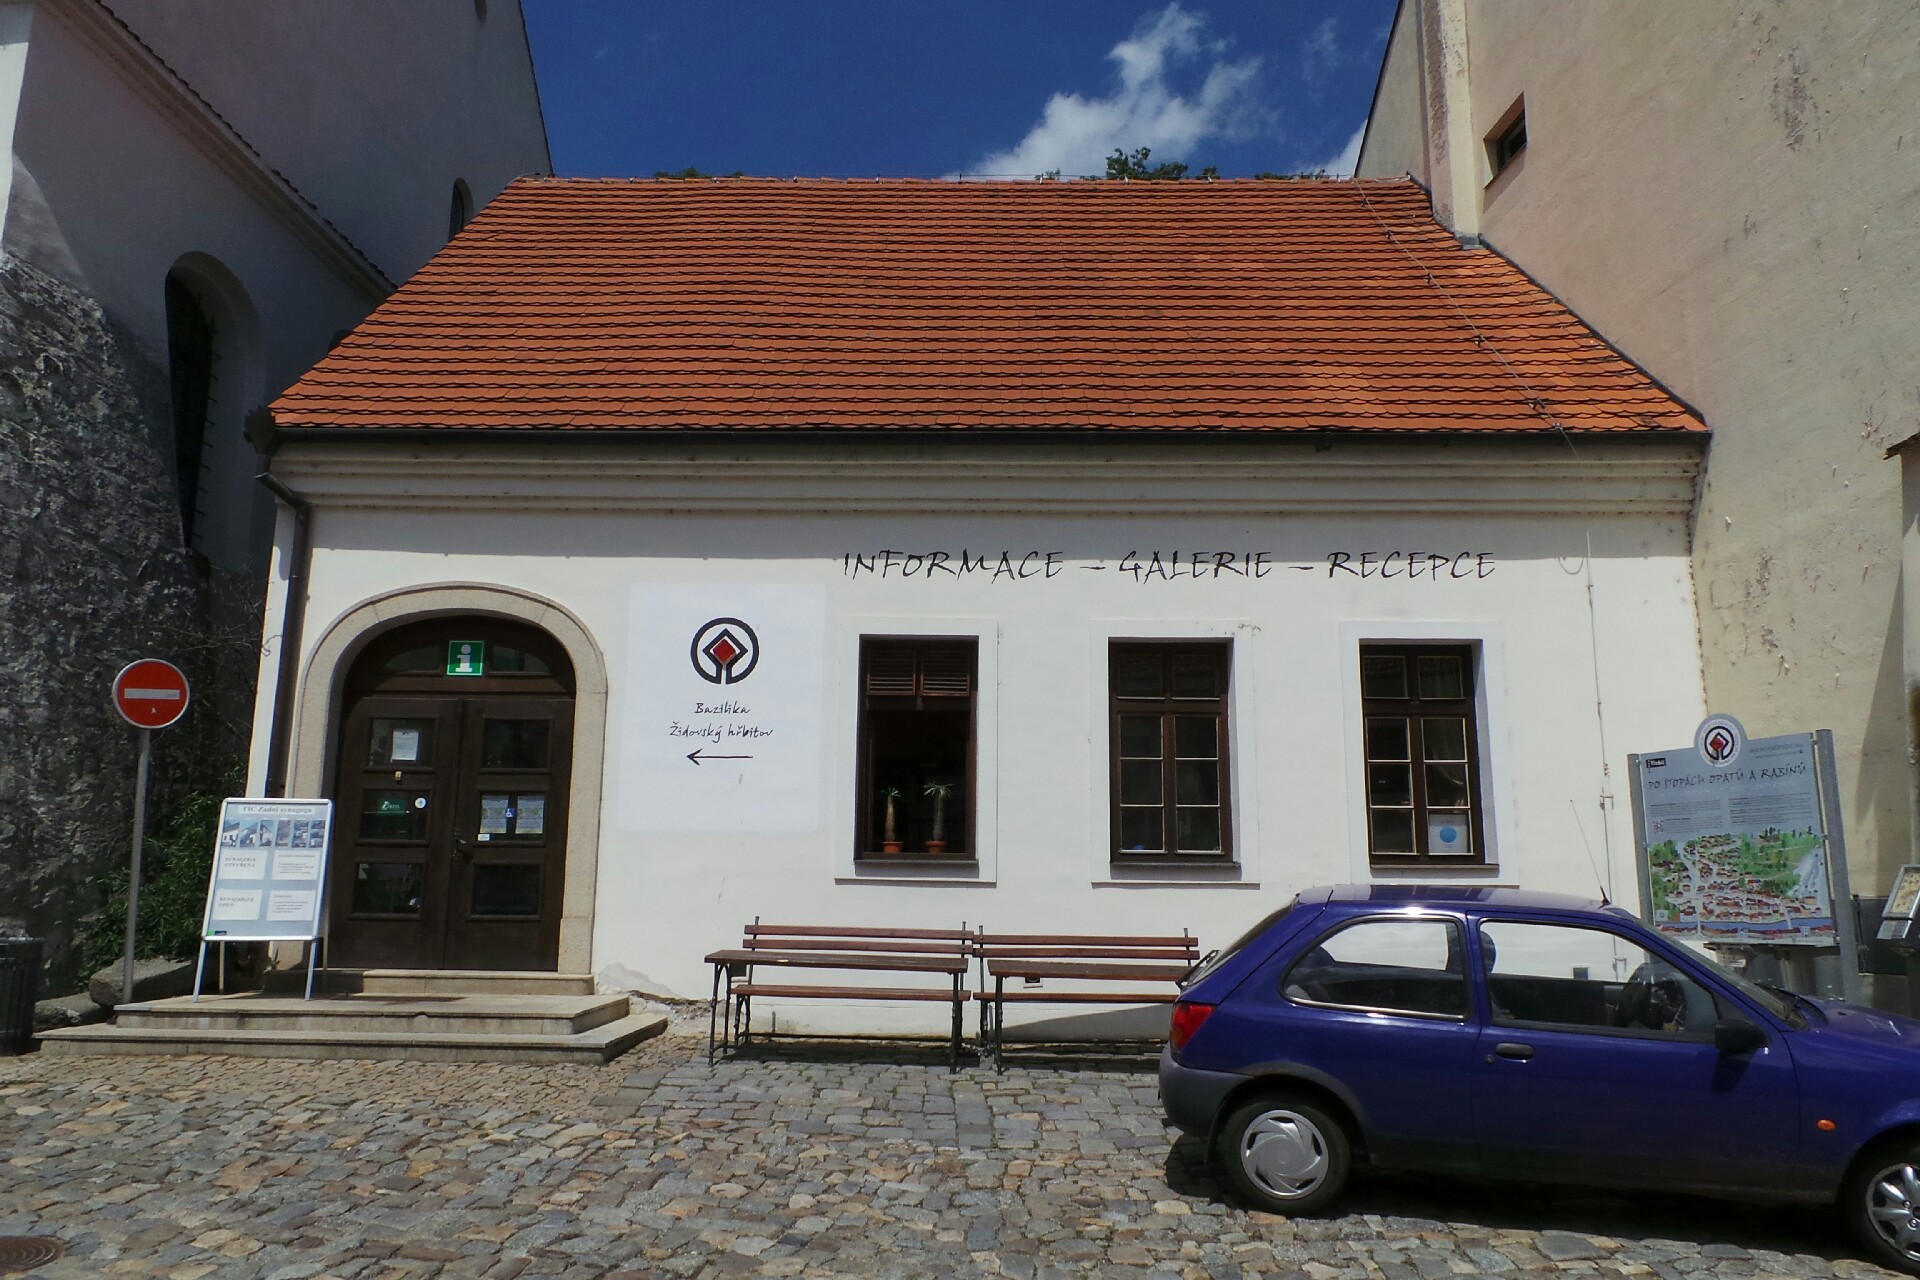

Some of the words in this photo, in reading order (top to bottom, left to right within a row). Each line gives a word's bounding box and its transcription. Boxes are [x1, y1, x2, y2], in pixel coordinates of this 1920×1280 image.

[843, 548, 1064, 584] INFORMACE
[1118, 549, 1273, 585] GALERIE
[1327, 550, 1495, 582] RECEPCE
[694, 701, 750, 714] Bazilika
[669, 721, 723, 744] Židovský
[727, 723, 774, 738] hřbitov
[1648, 780, 1661, 791] PO
[1749, 772, 1757, 781] A
